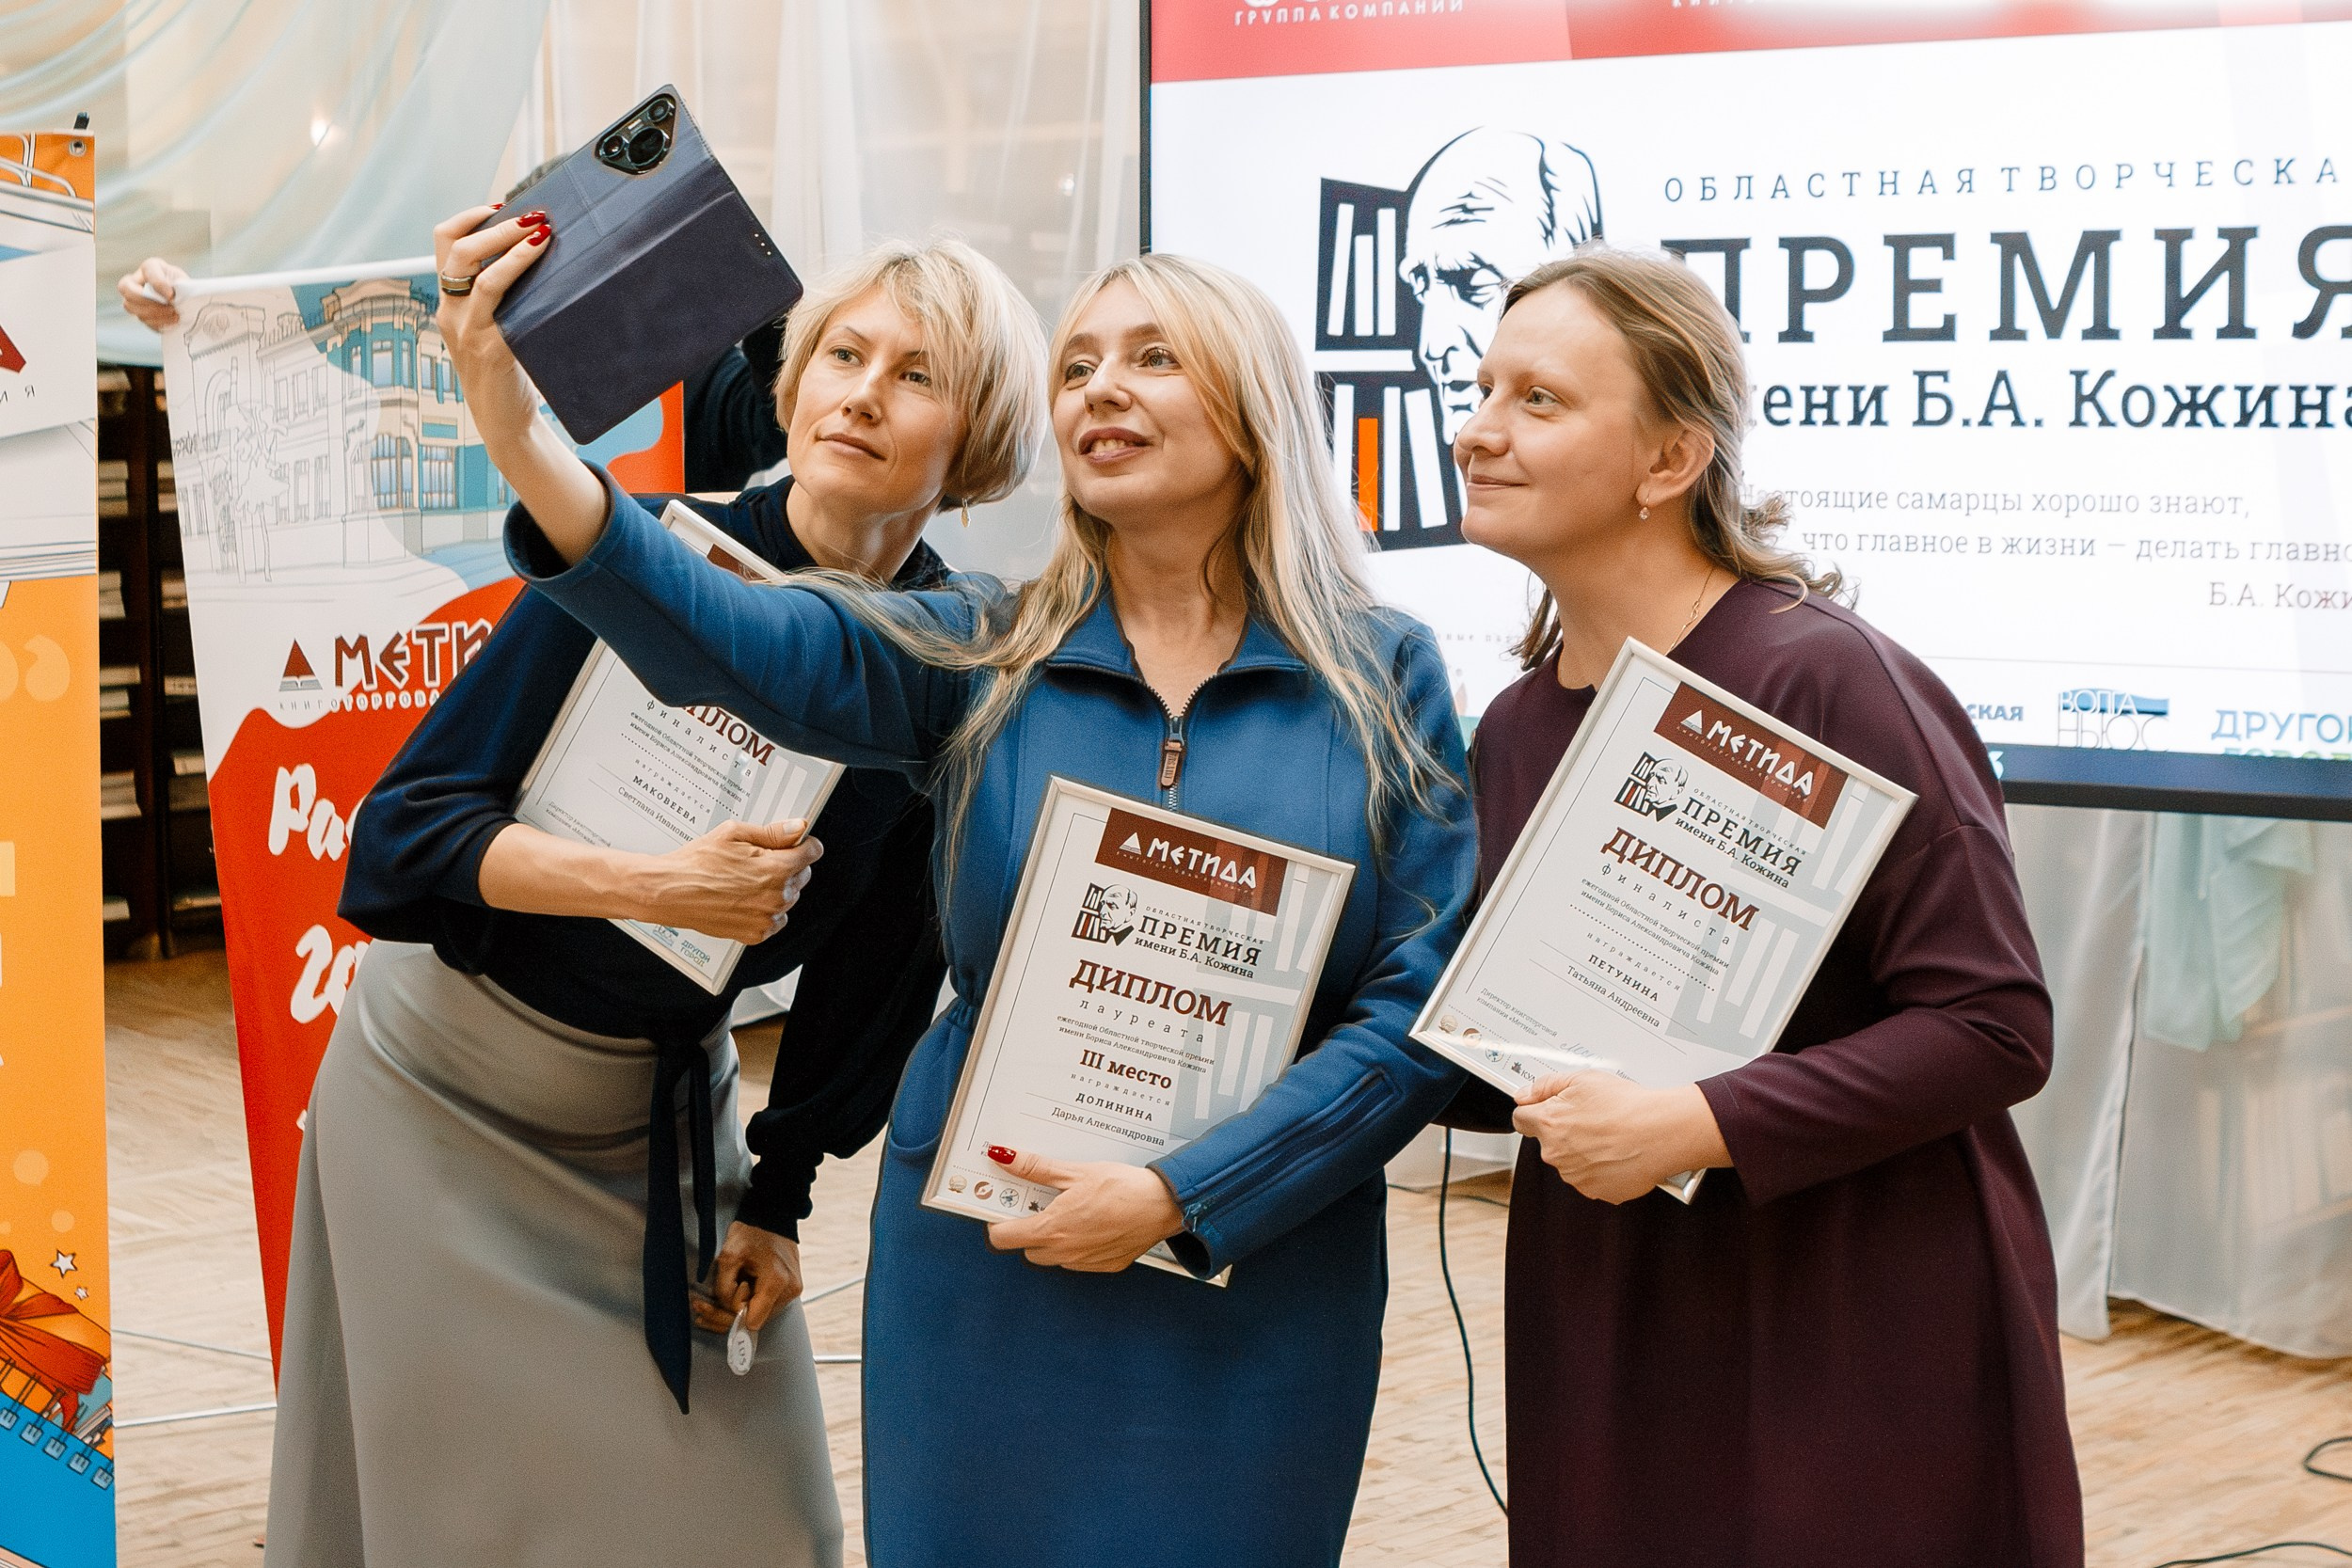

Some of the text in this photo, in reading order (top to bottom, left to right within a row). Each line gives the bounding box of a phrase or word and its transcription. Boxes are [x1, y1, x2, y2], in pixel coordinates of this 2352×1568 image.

[1234, 0, 1464, 26] ГРУППА КОМПАНИИ
[1664, 157, 2339, 202] ОБЛАСТНАЯ ТВОРЧЕСКА
[1660, 225, 2352, 343] ПРЕМИЯ
[1748, 384, 1890, 428] ени
[1913, 370, 2042, 428] Б.А.
[1897, 490, 2022, 515] самарцы
[2031, 494, 2139, 517] хорошо
[2150, 495, 2249, 519] знают,
[1802, 532, 1849, 551] что
[1857, 532, 1968, 553] главное
[1978, 535, 1993, 554] в
[2001, 537, 2096, 556] жизни
[2137, 539, 2240, 562] делать
[2209, 582, 2264, 608] Б.А.
[630, 721, 649, 738] имени
[650, 735, 671, 755] Бориса
[646, 700, 752, 777] финалиста
[2211, 709, 2352, 743] ДРУГО
[1706, 720, 1813, 796] МЕТИДА
[618, 786, 656, 816] Светлана
[632, 775, 697, 825] МАКОВЕЕВА
[635, 758, 711, 814] награждается
[268, 763, 365, 862] Ра
[1681, 797, 1802, 877] ПРЕМИЯ
[1693, 788, 1806, 856] ОБЛАСТНАЯ ТВОРЧЕСКАЯ
[1146, 837, 1256, 889] МЕТИДА
[1675, 817, 1789, 889] имени Б.А. Кожина
[1600, 827, 1760, 931] ДИПЛОМ
[1601, 863, 1730, 945] финалиста
[1138, 915, 1262, 966] ПРЕМИЯ
[1145, 906, 1264, 945] ОБЛАСТНАЯ ТВОРЧЕСКАЯ
[1581, 878, 1729, 969] ежегодной Областной творческой премии
[1581, 890, 1719, 975] имени Бориса Александровича Кожина
[1135, 937, 1254, 978] имени Б.А. Кожина
[1586, 931, 1680, 990] награждается
[1588, 954, 1660, 1003] ПЕТУНИНА
[1069, 959, 1232, 1027] ДИПЛОМ
[1476, 997, 1509, 1020] компании
[1480, 988, 1511, 1010] Директор
[1511, 1006, 1558, 1037] книготорговой
[1566, 965, 1661, 1028] Татьяна Андреевна
[1057, 1015, 1215, 1066] ежегодной Областной творческой премии
[1079, 999, 1204, 1043] лауреата
[1058, 1026, 1207, 1074] имени Бориса Александровича Кожина
[1106, 1060, 1172, 1090] место
[1070, 1072, 1171, 1106] награждается
[1075, 1091, 1153, 1122] ДОЛИНИНА
[1051, 1106, 1166, 1148] Дарья Александровна
